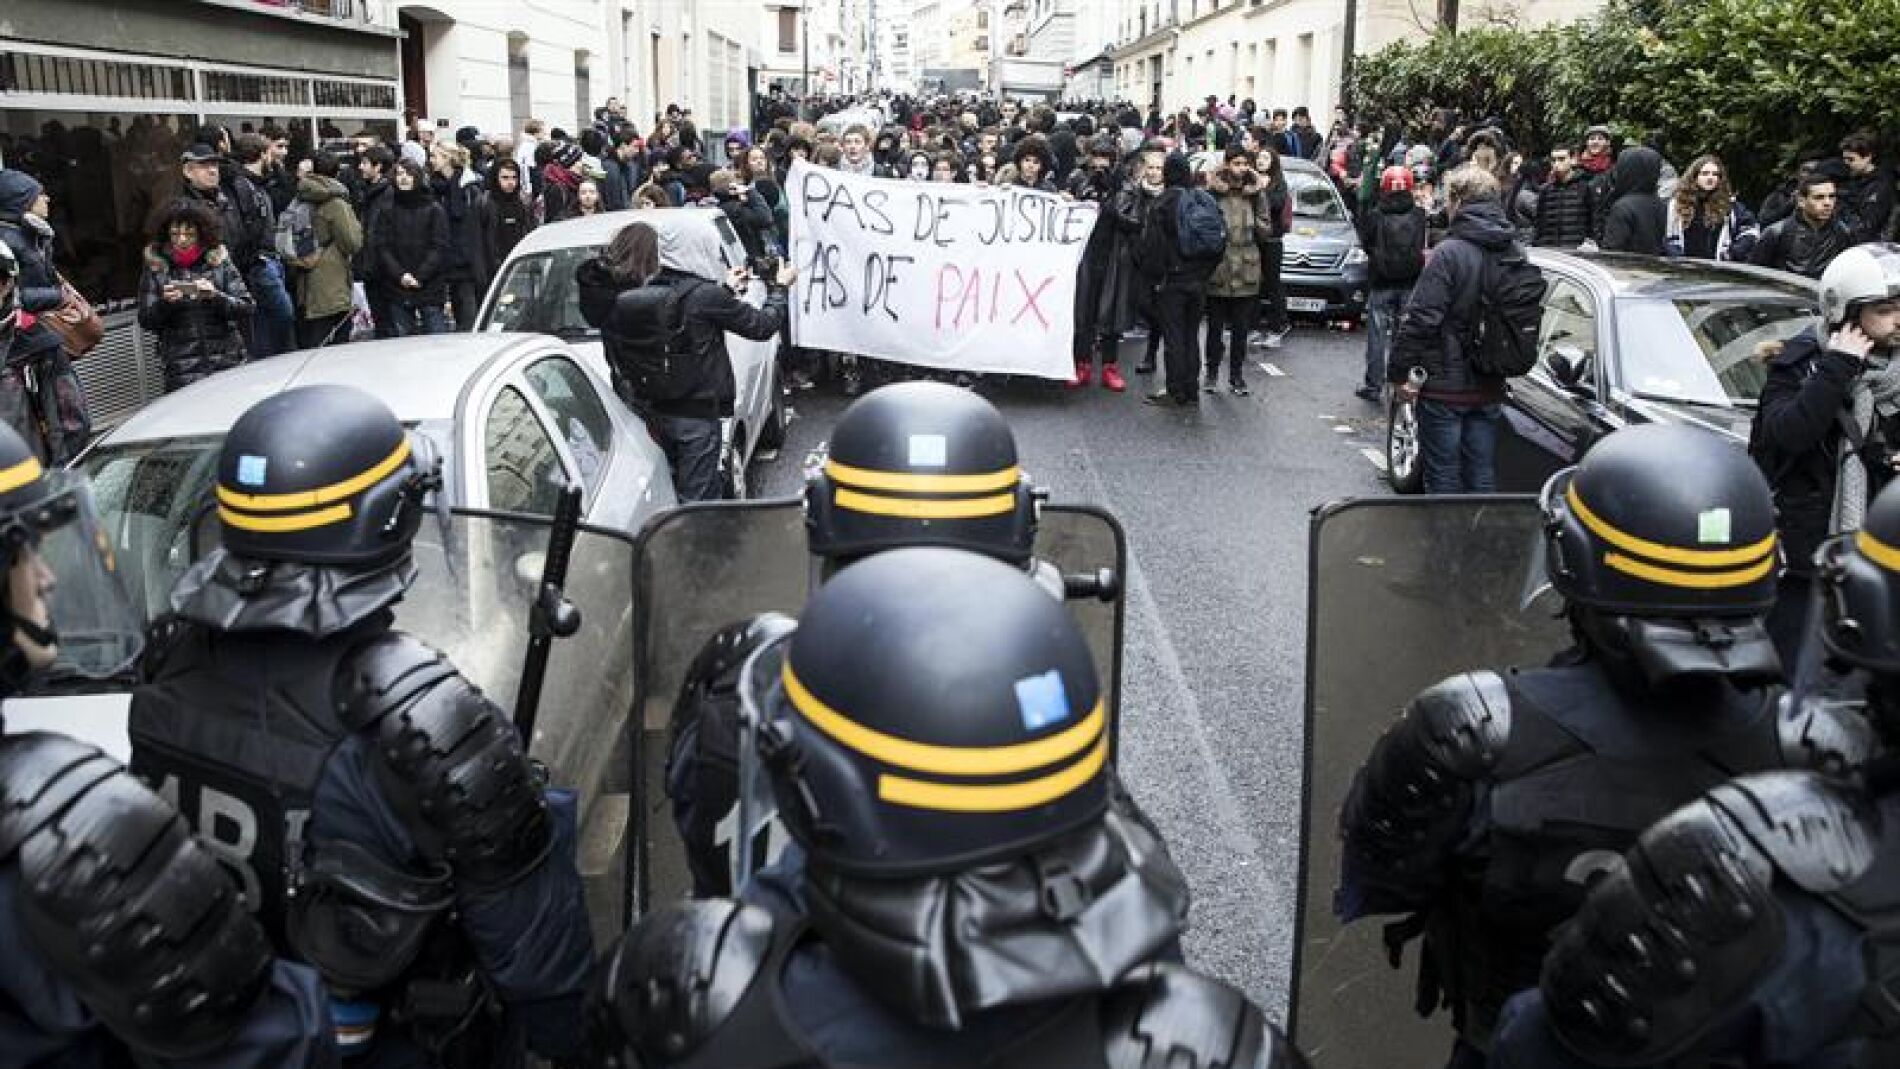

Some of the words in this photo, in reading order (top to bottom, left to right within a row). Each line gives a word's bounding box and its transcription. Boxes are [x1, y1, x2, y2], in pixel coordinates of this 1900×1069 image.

[803, 171, 894, 235] PAS
[913, 192, 966, 247] DE
[978, 191, 1100, 245] JUSTICE
[862, 251, 915, 322] DE
[935, 262, 1056, 330] PAIX
